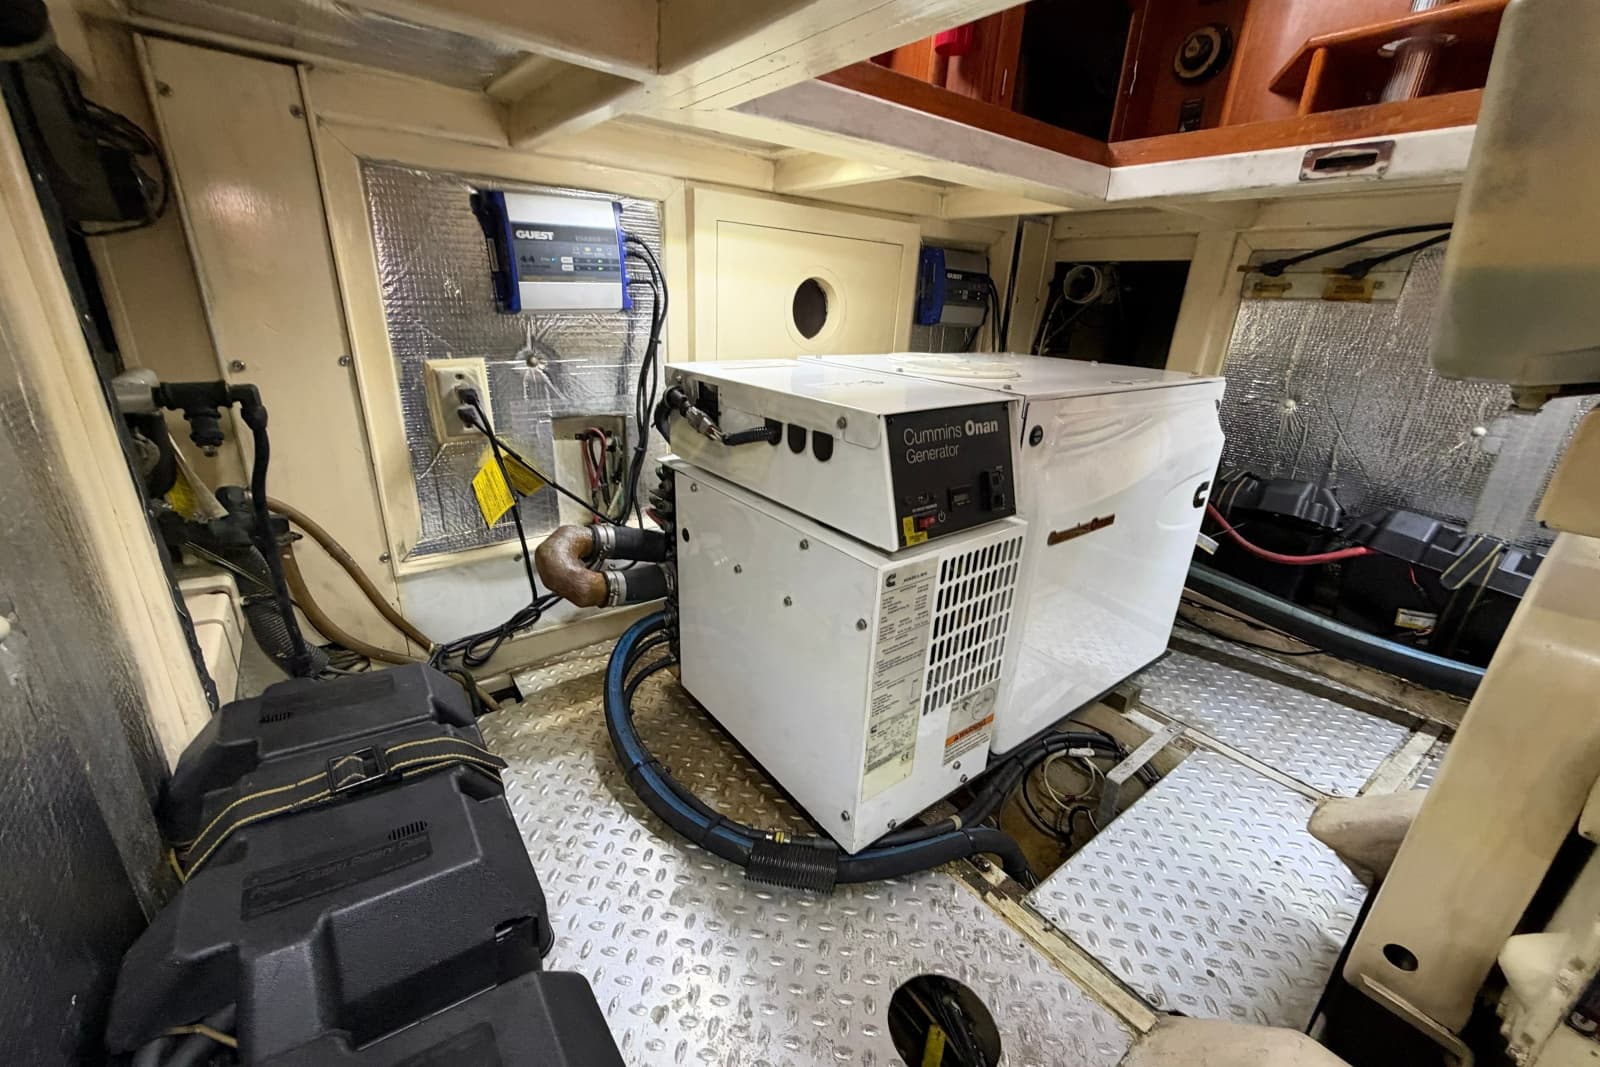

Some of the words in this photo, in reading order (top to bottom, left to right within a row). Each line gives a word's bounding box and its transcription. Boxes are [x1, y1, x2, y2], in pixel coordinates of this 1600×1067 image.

[515, 230, 554, 240] GUEST
[904, 424, 962, 445] Cummins
[965, 419, 998, 436] Onan
[906, 444, 959, 464] Generator
